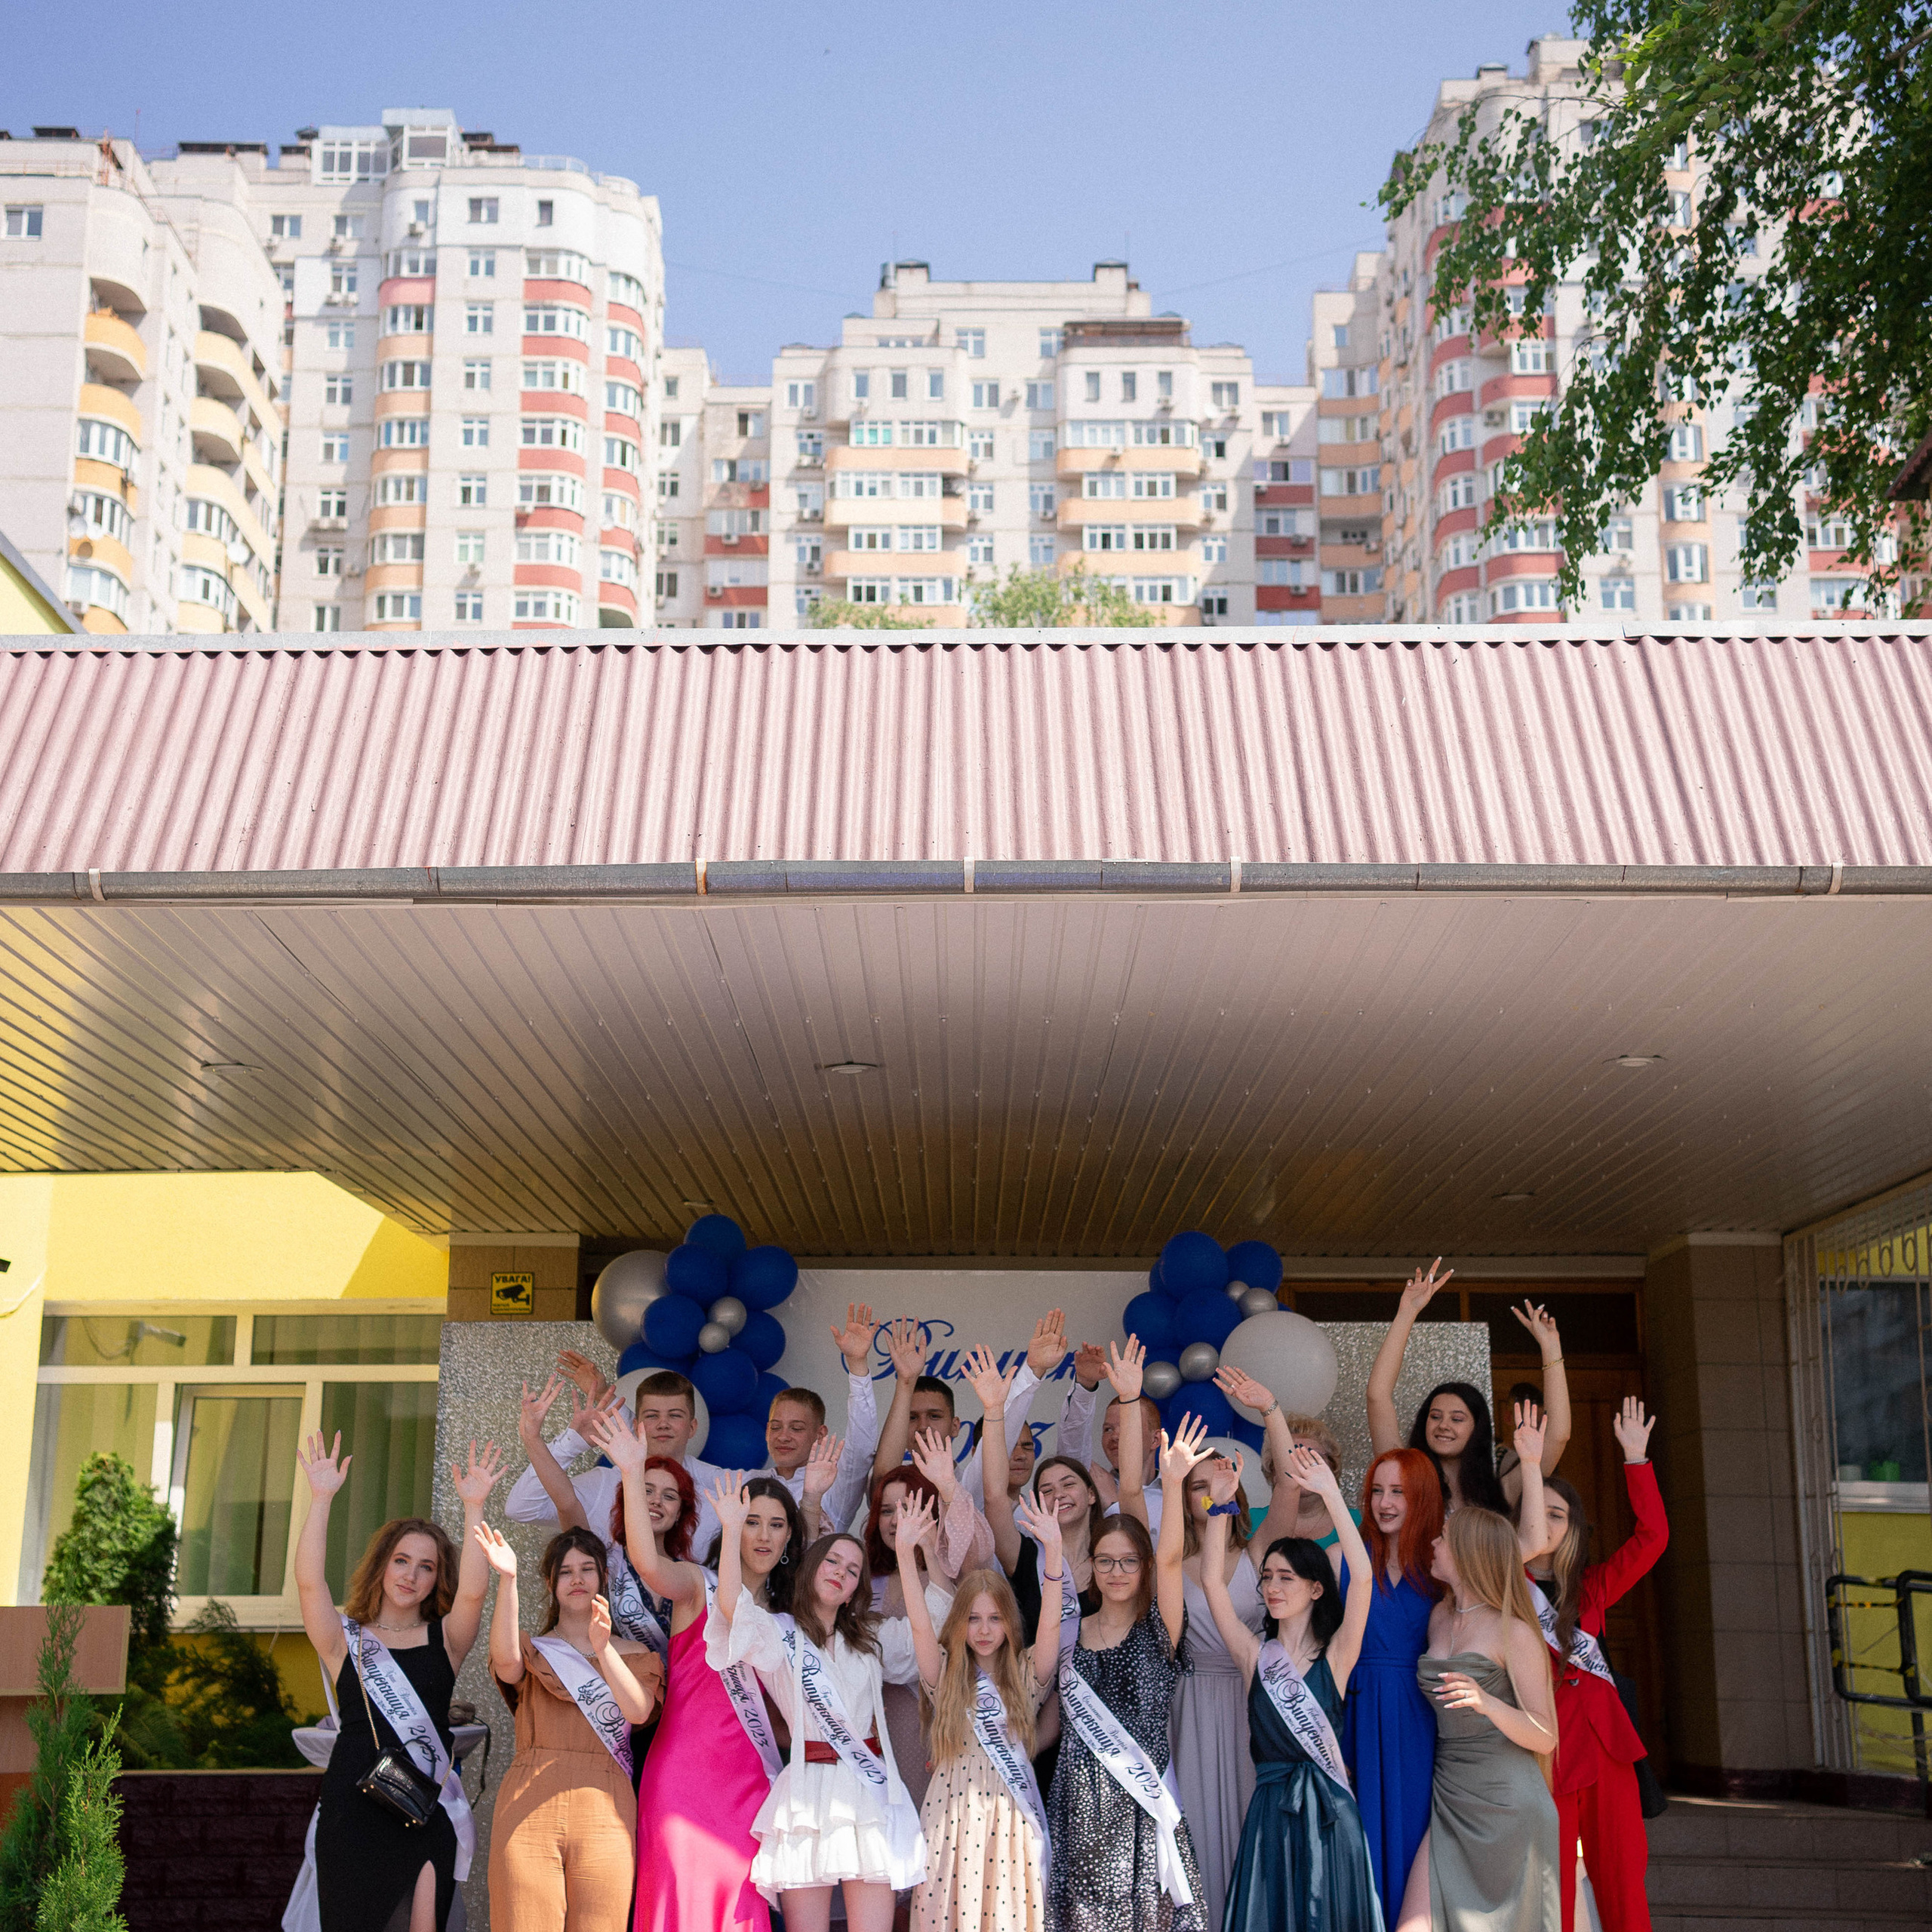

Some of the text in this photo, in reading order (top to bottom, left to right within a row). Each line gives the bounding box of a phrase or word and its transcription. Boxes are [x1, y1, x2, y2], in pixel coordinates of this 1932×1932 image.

[743, 1708, 770, 1747] 2023
[971, 1693, 1028, 1792] Випускниця
[1059, 1665, 1121, 1758] Випускниця
[1125, 1762, 1162, 1799] 2023
[851, 1749, 888, 1785] 2023
